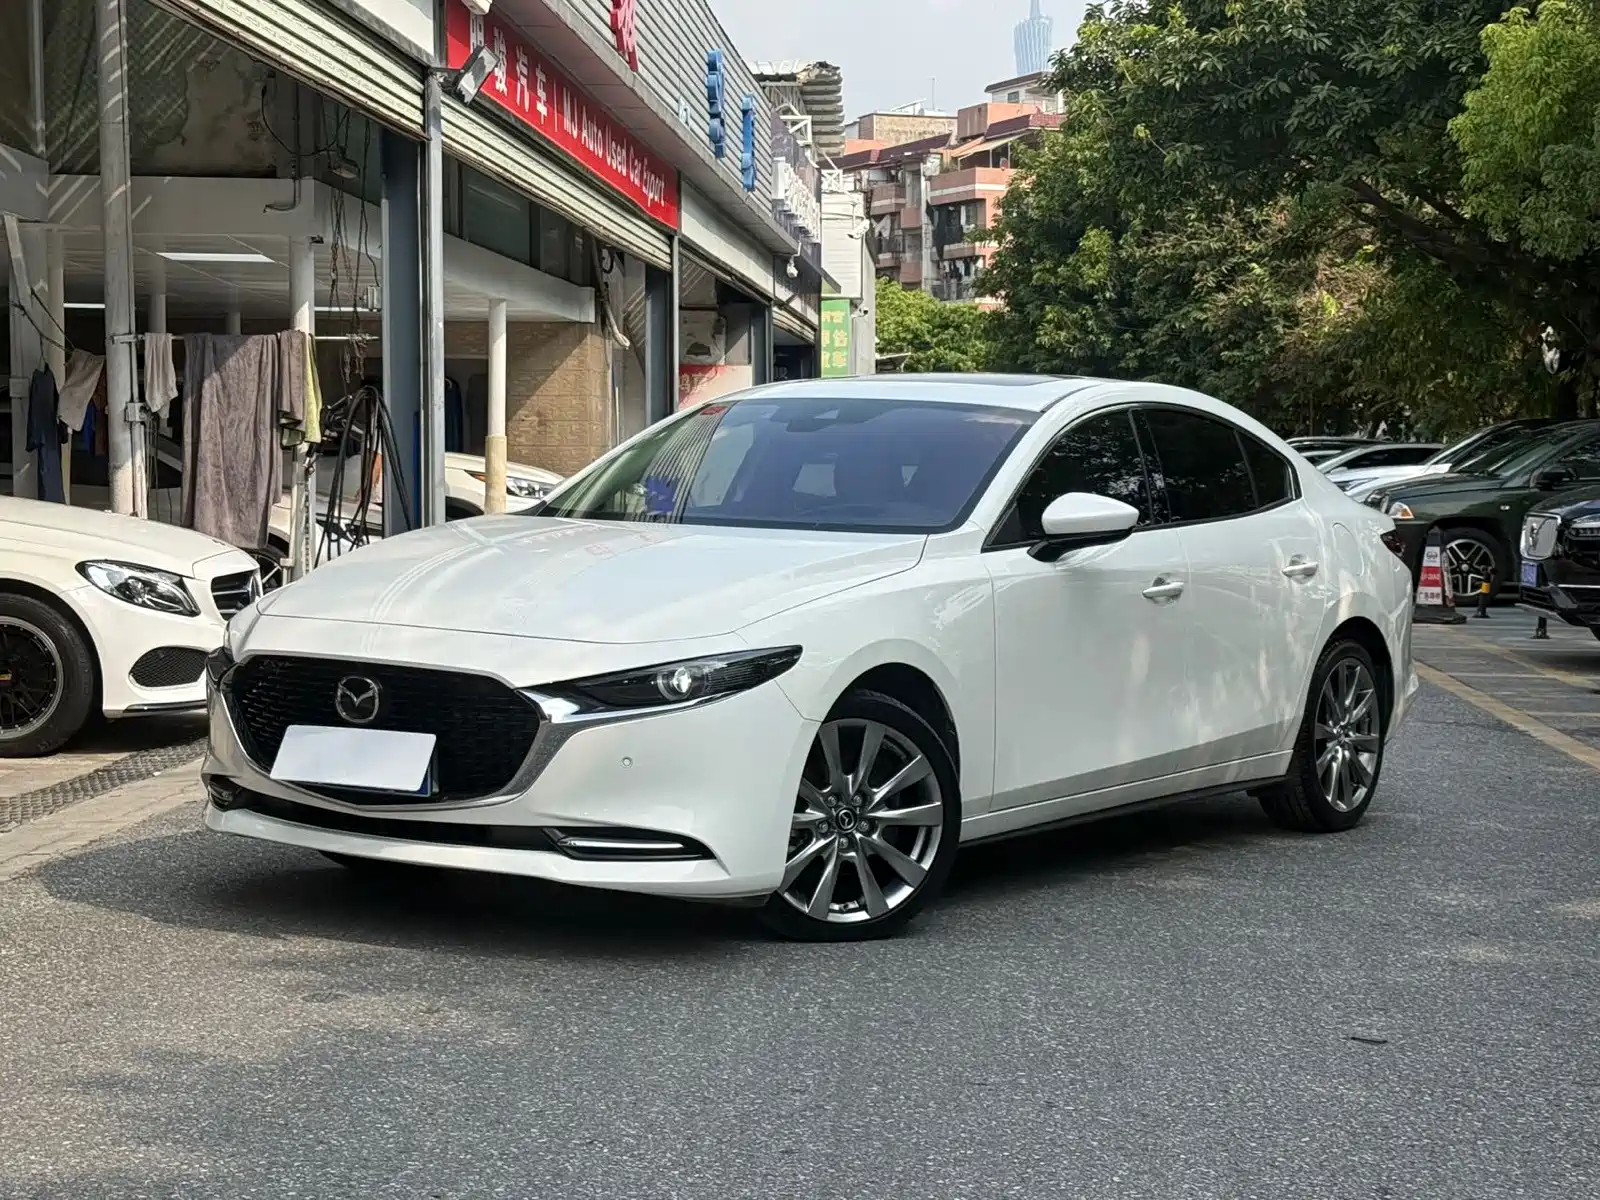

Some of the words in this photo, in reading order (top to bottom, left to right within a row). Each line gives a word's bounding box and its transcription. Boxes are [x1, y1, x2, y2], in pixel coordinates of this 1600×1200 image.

[563, 87, 578, 139] MJ
[581, 105, 603, 158] Auto
[605, 124, 627, 177] Used
[629, 144, 642, 188] Car
[642, 157, 665, 207] Export
